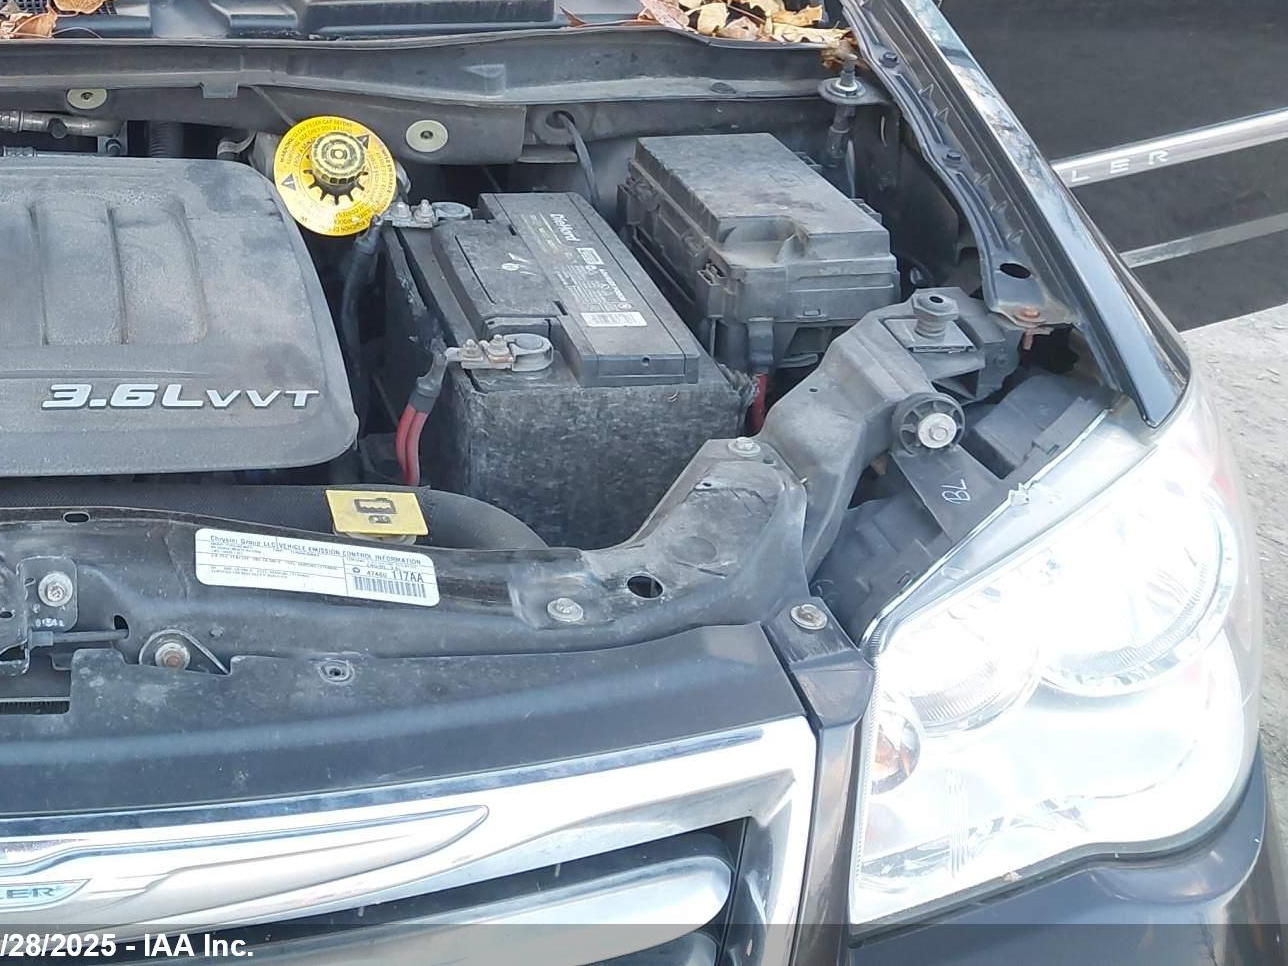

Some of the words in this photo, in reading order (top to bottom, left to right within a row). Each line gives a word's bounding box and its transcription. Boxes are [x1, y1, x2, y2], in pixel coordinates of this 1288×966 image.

[308, 546, 340, 555] EMISSION
[342, 550, 372, 559] CONTROL
[375, 554, 421, 565] INFORMATION
